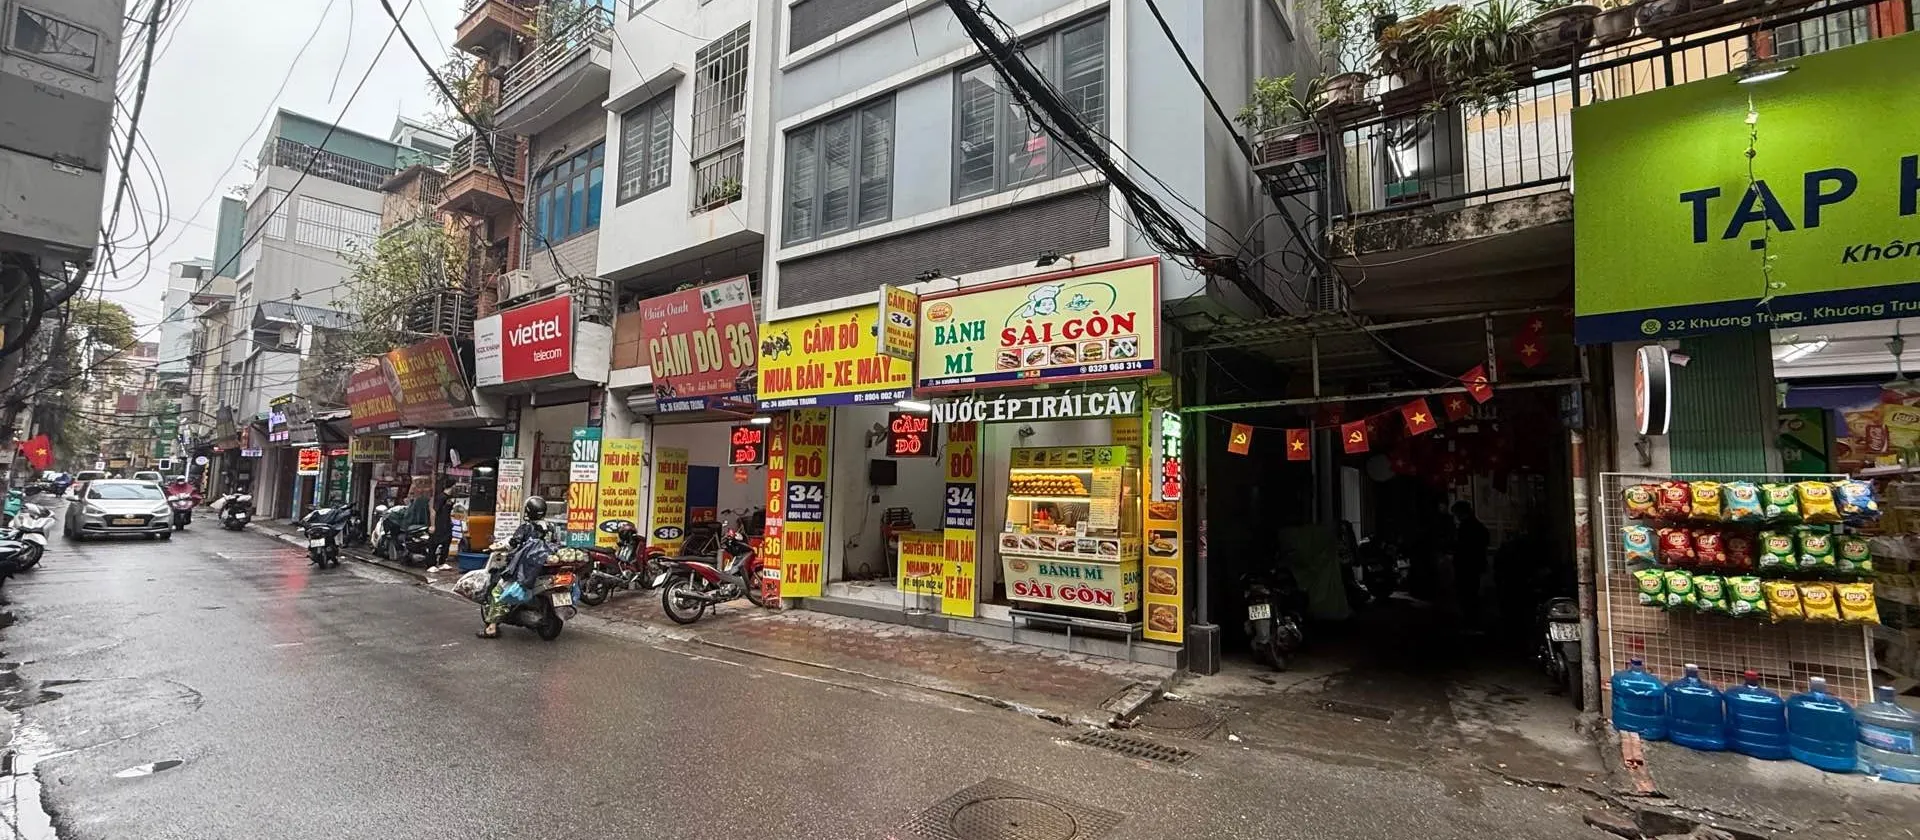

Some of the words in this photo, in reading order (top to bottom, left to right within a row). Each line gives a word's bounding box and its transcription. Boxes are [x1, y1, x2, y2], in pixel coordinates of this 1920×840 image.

[1679, 168, 1858, 250] TẠP
[891, 313, 912, 327] 34
[1000, 318, 1053, 347] SÀI
[1061, 310, 1137, 340] GÒN
[1668, 320, 1685, 331] 32
[1690, 315, 1751, 329] Khương
[1814, 303, 1884, 319] Khương
[509, 315, 562, 347] viettel
[803, 318, 835, 354] CẦM
[839, 313, 859, 349] ĐỒ
[889, 337, 897, 345] XE
[934, 318, 986, 346] BÁNH
[533, 348, 562, 362] telecom
[649, 321, 693, 378] CẦM
[693, 312, 723, 373] ĐỒ
[725, 322, 755, 368] 36
[944, 346, 974, 375] MÌ
[1088, 364, 1108, 373] 0329
[1126, 361, 1142, 370] 314
[763, 366, 793, 394] MUA
[796, 359, 825, 391] BÁN
[834, 360, 853, 387] XE
[931, 396, 987, 424] NƯỚC
[993, 392, 1021, 419] ÉP
[1029, 389, 1082, 419] TRÁI
[1088, 386, 1137, 415] CÂY
[733, 427, 761, 445] CẦM
[792, 417, 827, 447] CẦM
[891, 414, 929, 434] CẦM
[572, 439, 599, 461] SIM
[736, 446, 756, 463] ĐỒ
[895, 434, 922, 454] ĐỒ
[794, 447, 823, 478] ĐỒ
[951, 443, 973, 478] ĐỒ
[495, 488, 520, 513] SIM
[570, 482, 597, 510] SIM
[789, 484, 824, 502] 34
[946, 486, 975, 506] 34
[602, 508, 617, 517] CÁC
[618, 510, 635, 519] LOẠI
[656, 515, 669, 524] CÁC
[659, 528, 679, 539] 36
[785, 531, 804, 551] MUA
[805, 526, 822, 551] BÁN
[764, 537, 781, 556] 36
[944, 538, 959, 562] MUA
[960, 535, 974, 563] BÁN
[785, 563, 798, 585] XE
[799, 560, 820, 584] MÁY
[906, 560, 930, 573] NHANH
[1039, 563, 1081, 578] BÁNH
[1085, 564, 1104, 581] MÌ
[944, 579, 956, 599] XE
[956, 573, 973, 601] MÁY
[1014, 580, 1054, 599] SÀI
[1059, 583, 1114, 606] GÒN
